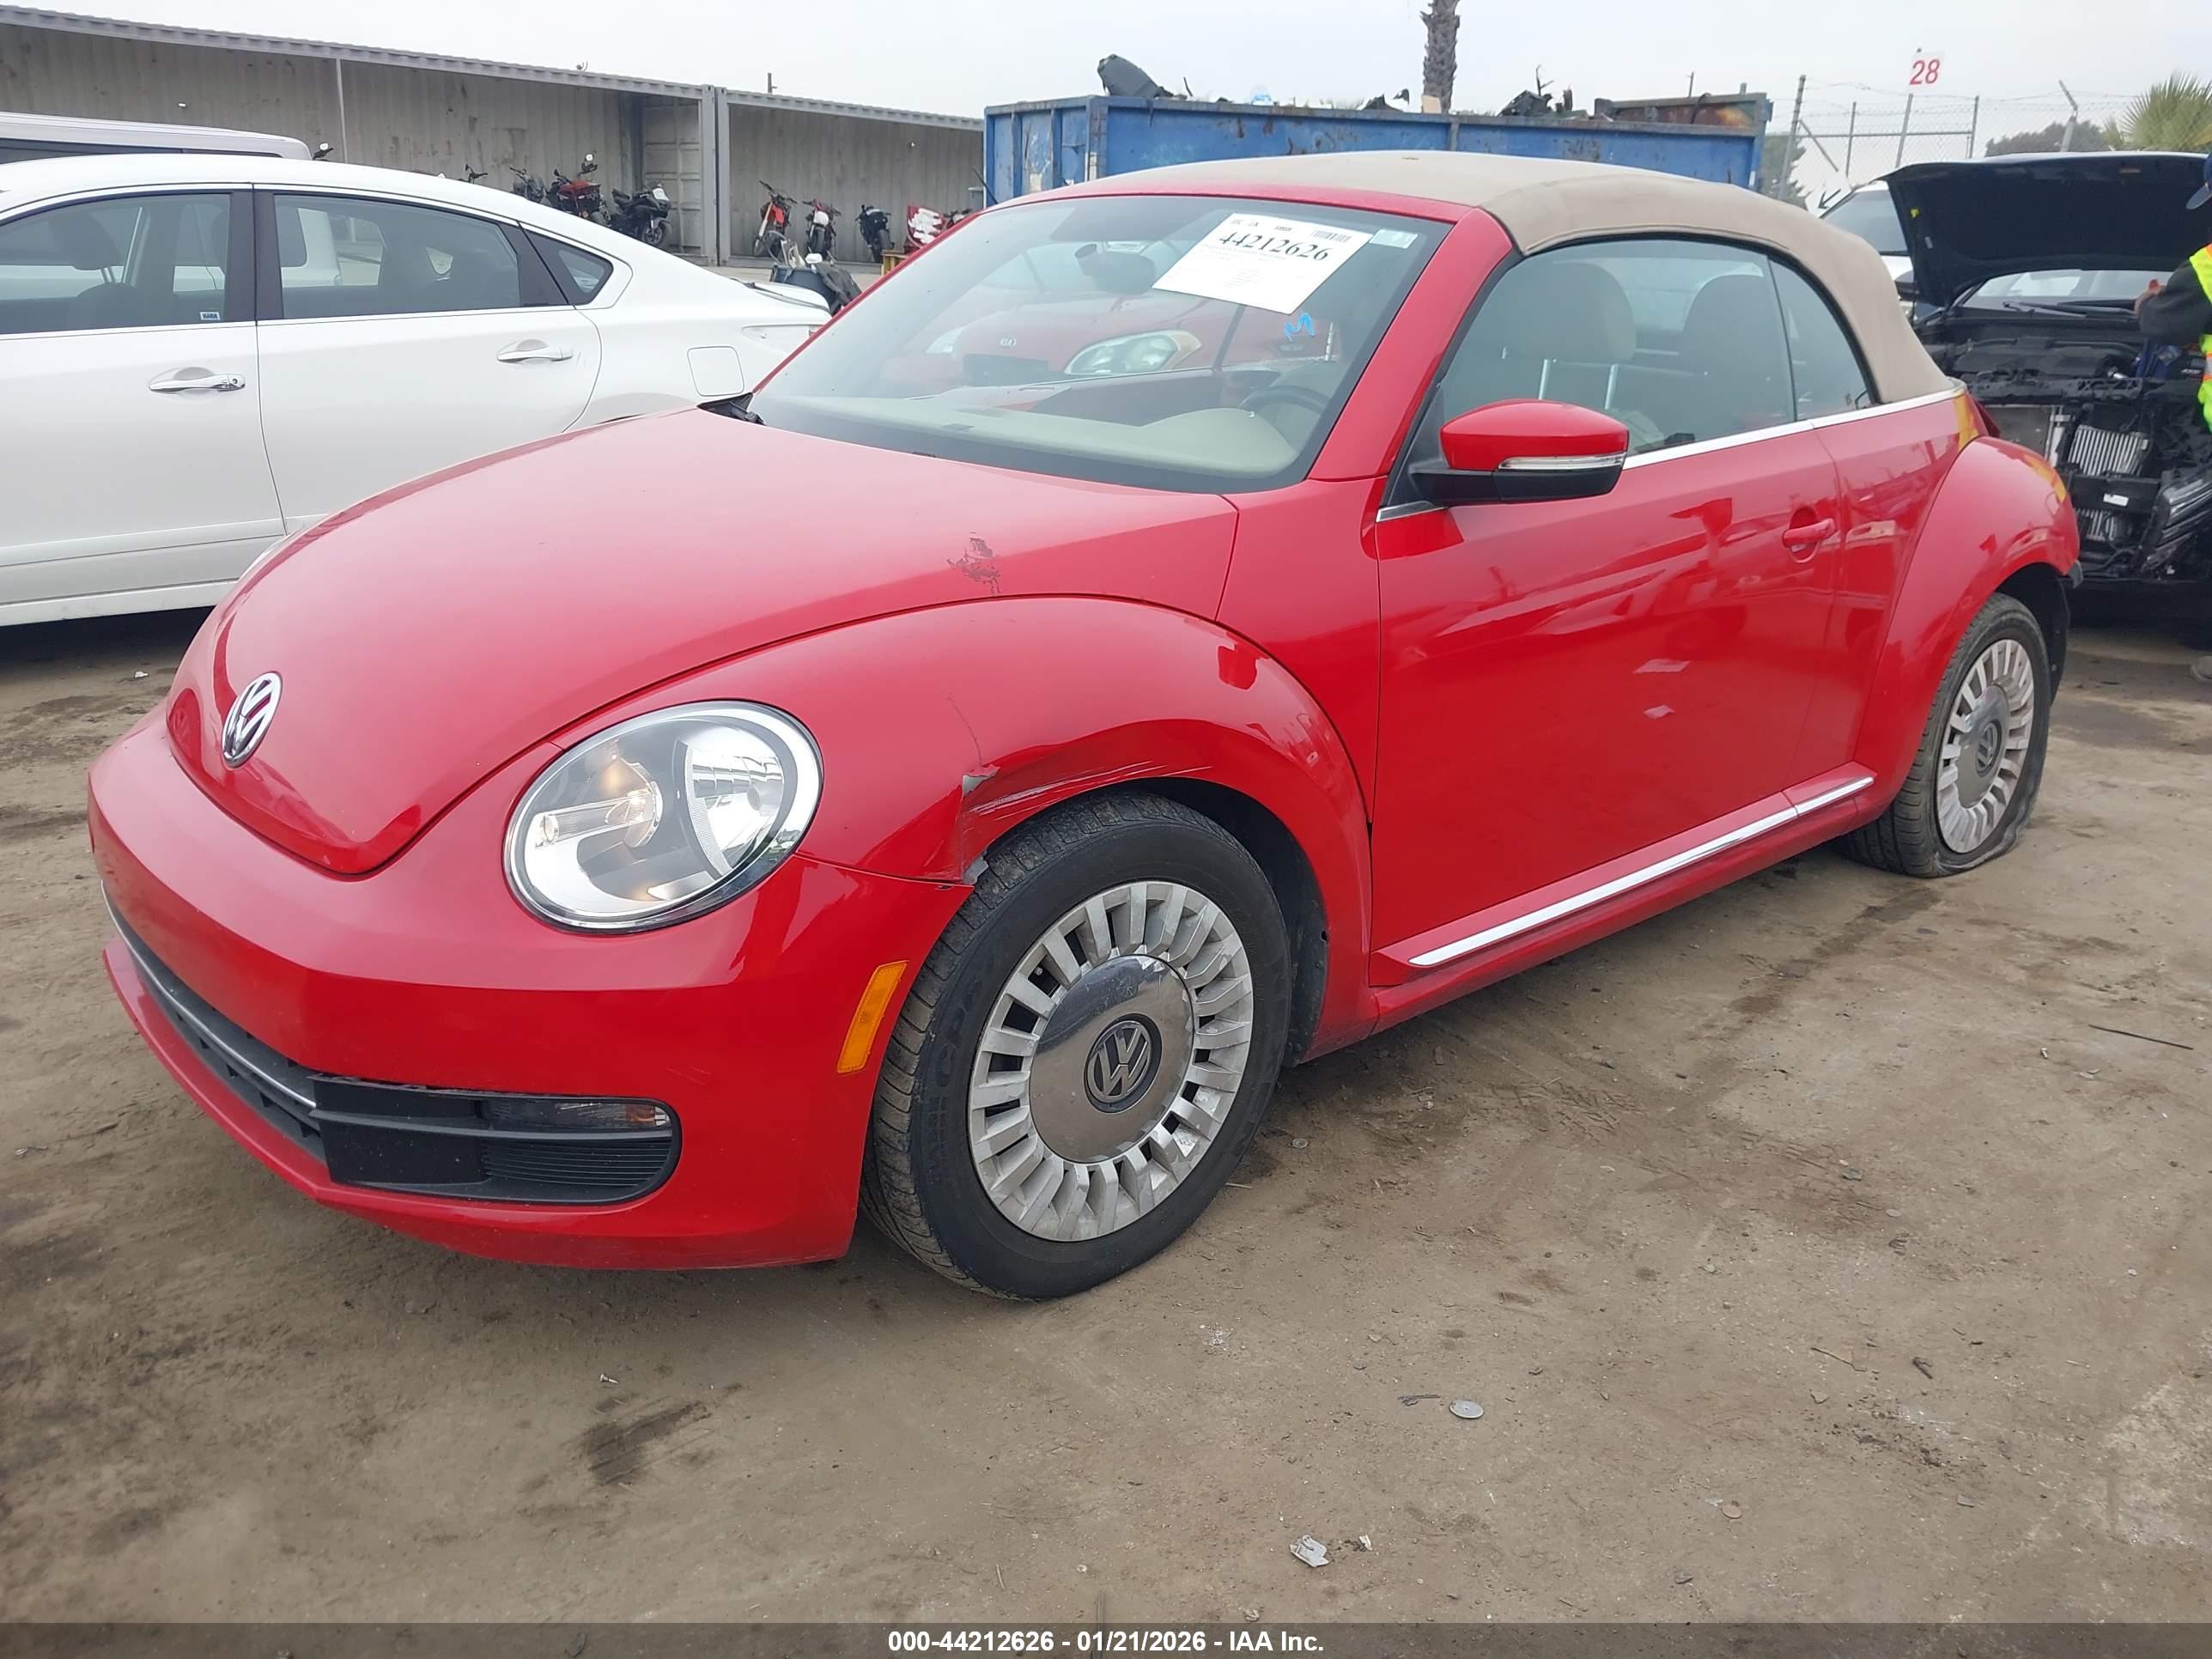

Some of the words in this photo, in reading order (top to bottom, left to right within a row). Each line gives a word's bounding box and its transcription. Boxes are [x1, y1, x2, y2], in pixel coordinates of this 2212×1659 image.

[1910, 58, 1941, 85] 28
[1218, 232, 1334, 261] 44212626
[223, 672, 282, 764] VW
[1088, 1021, 1151, 1101] VW
